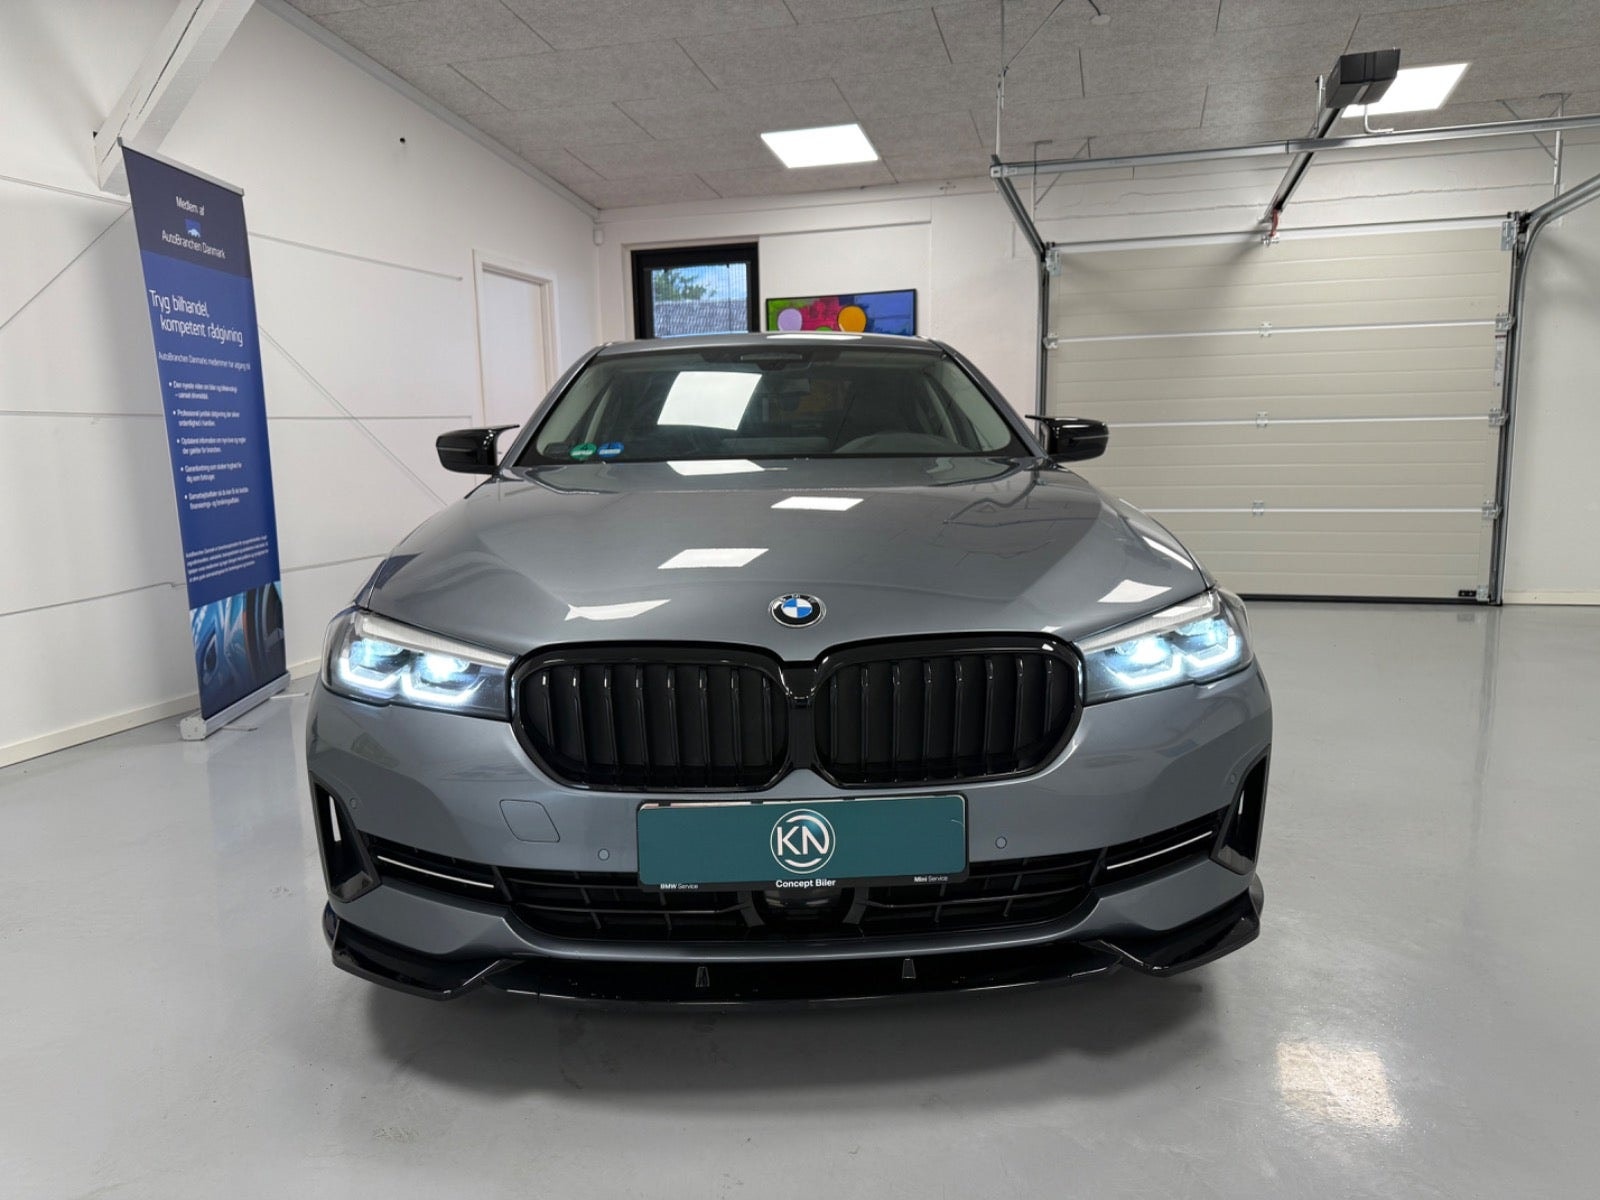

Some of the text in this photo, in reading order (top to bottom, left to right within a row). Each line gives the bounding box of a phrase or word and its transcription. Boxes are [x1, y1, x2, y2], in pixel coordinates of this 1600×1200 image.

[175, 195, 205, 216] Medlem af
[161, 230, 226, 259] AutoBranchen Danmark
[149, 290, 210, 318] Tryg bilhandel,
[160, 315, 244, 347] kompetent rådgivning
[678, 882, 699, 890] Service
[775, 878, 836, 889] Concept Biler
